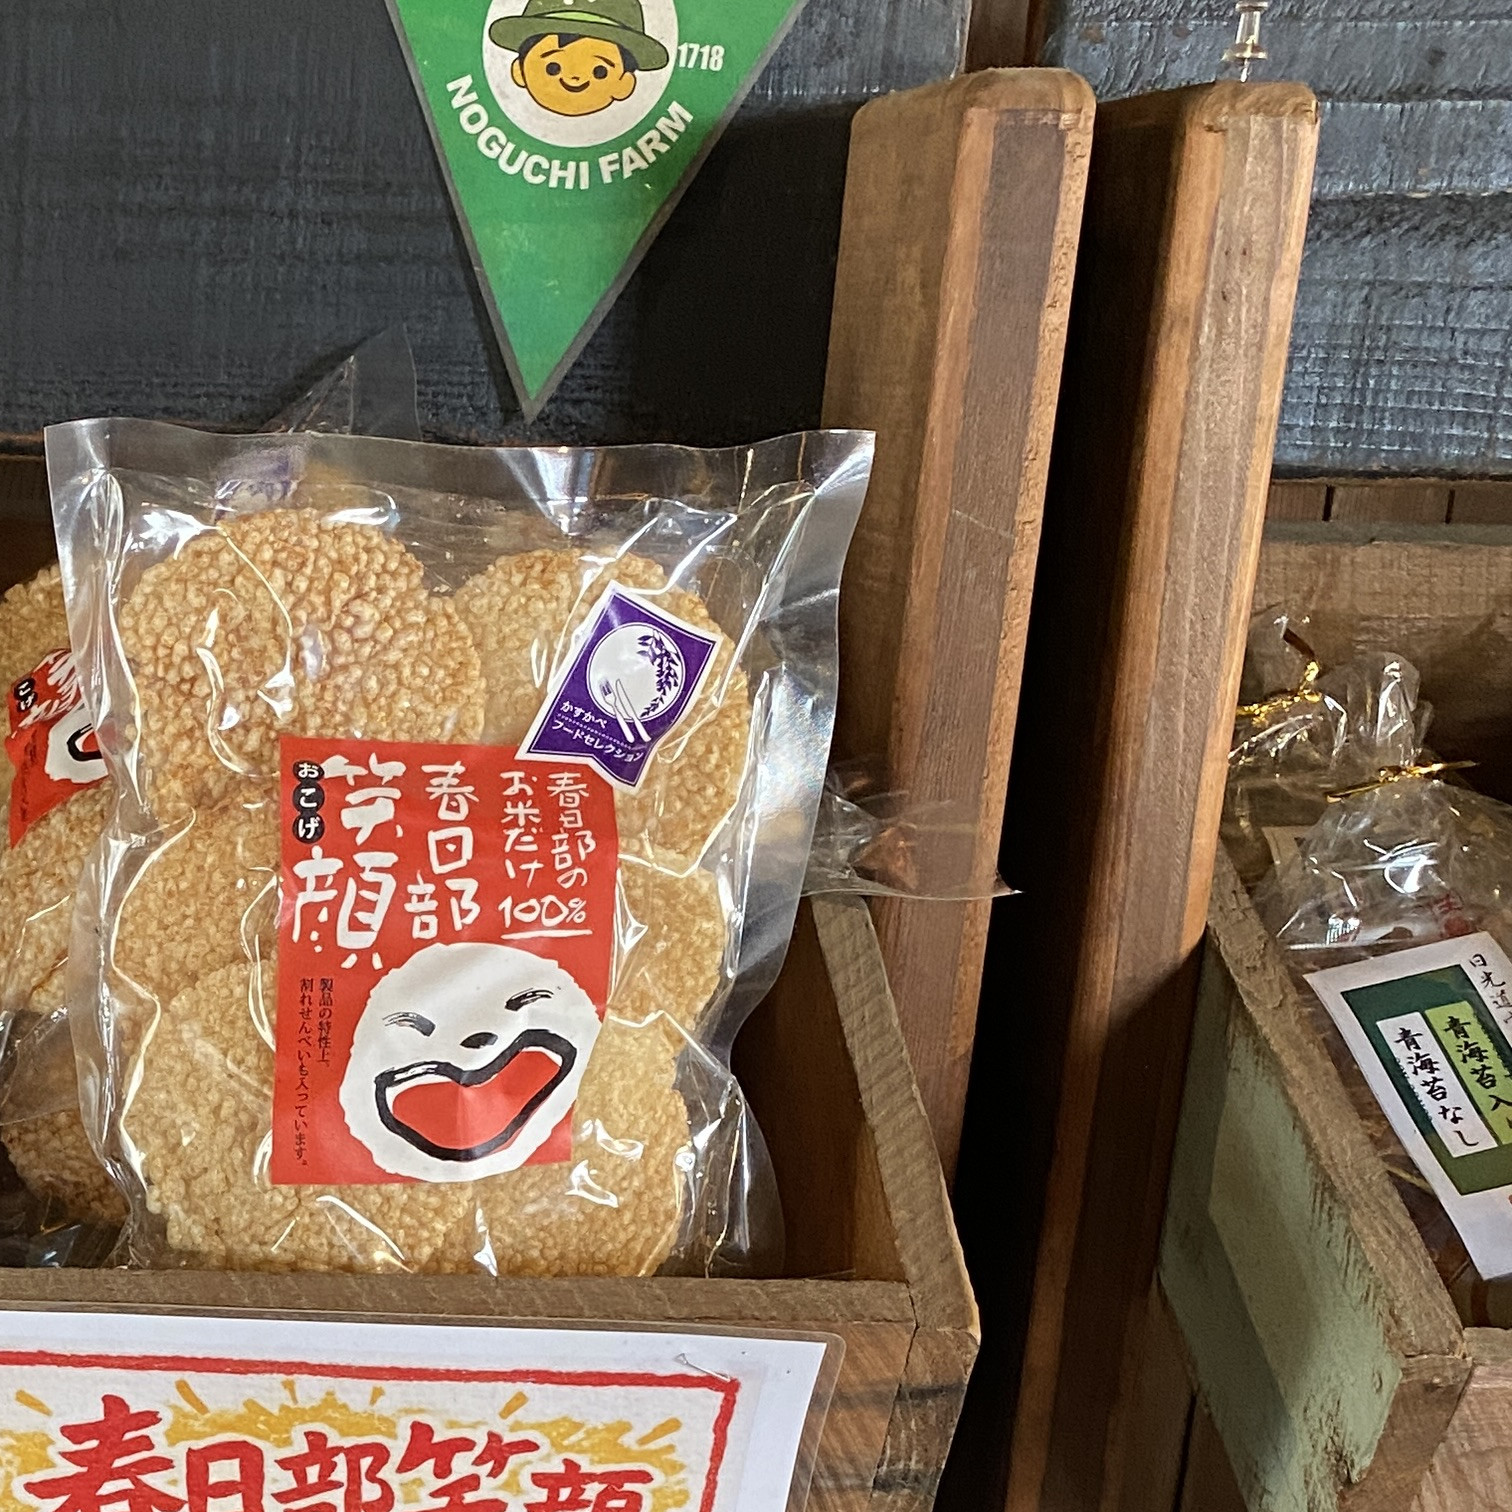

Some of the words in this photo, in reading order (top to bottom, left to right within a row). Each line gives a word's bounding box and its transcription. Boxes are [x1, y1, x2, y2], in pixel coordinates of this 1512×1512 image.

[676, 42, 725, 72] 1718
[446, 75, 589, 190] NOGUCHI
[598, 101, 694, 184] FARM
[551, 719, 644, 763] フードセレクション
[296, 761, 321, 840] おこげ
[404, 760, 482, 940] 春日部
[500, 771, 544, 888] お米だけ
[547, 771, 597, 890] 春日部の
[292, 752, 407, 970] 笑顔
[498, 894, 589, 929] 100%
[294, 977, 315, 1167] 割れせんべいも入っています。
[1394, 1027, 1479, 1147] 青海苔なし
